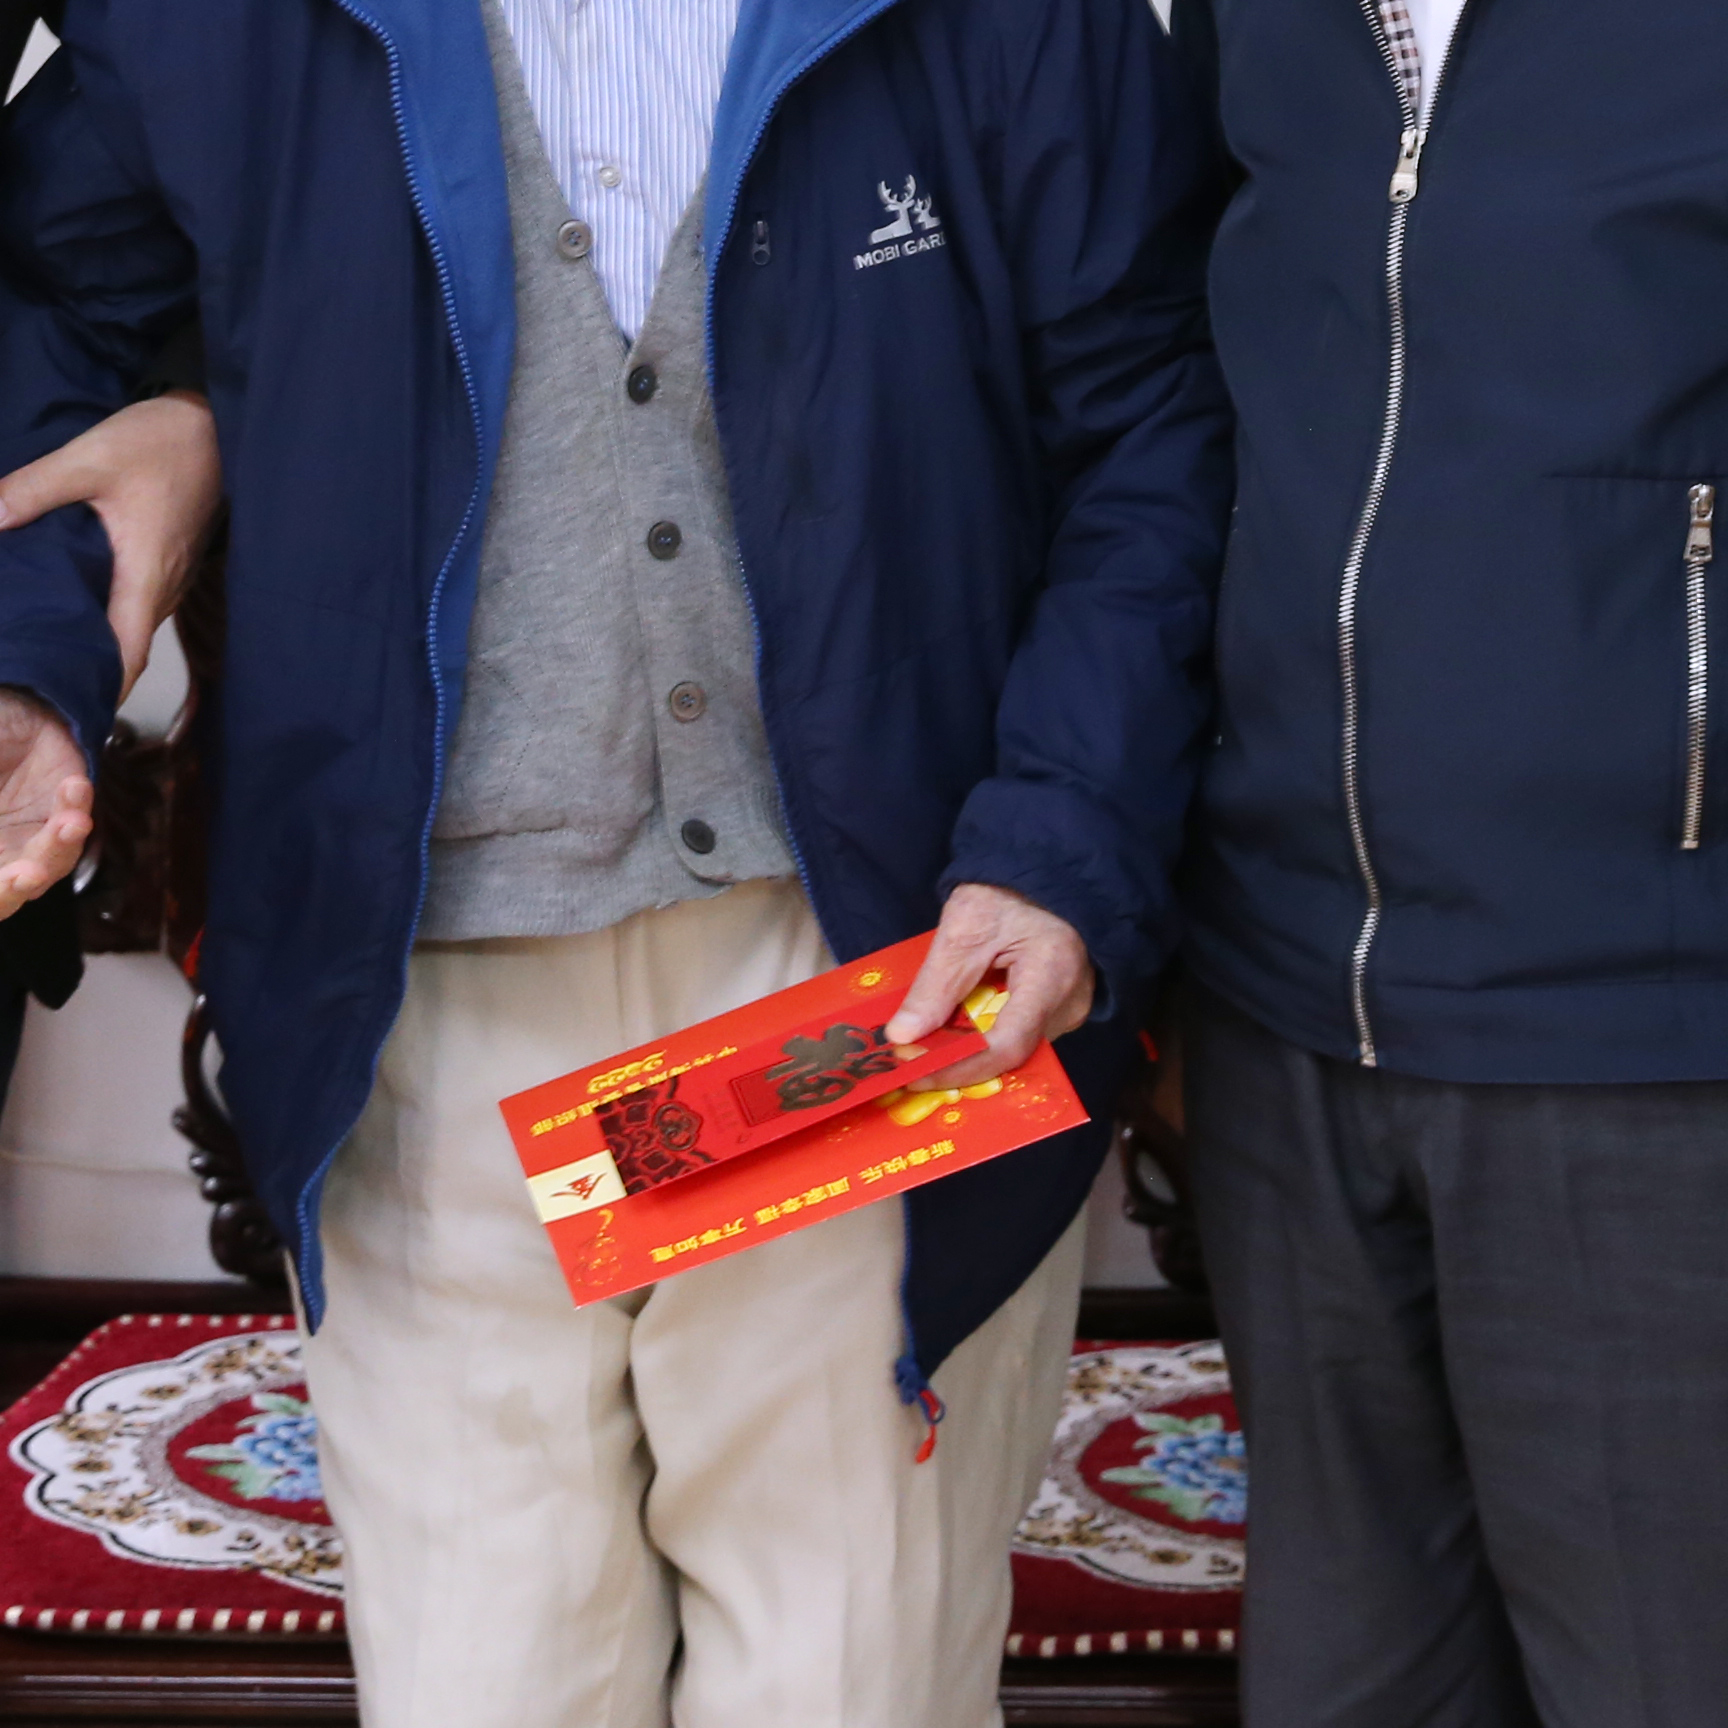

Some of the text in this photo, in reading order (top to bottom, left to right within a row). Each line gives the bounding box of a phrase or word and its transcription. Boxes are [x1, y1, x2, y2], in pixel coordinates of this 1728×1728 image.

[854, 244, 900, 269] MOBI
[864, 1137, 957, 1186] 新春快乐
[648, 1217, 748, 1265] 万事如意
